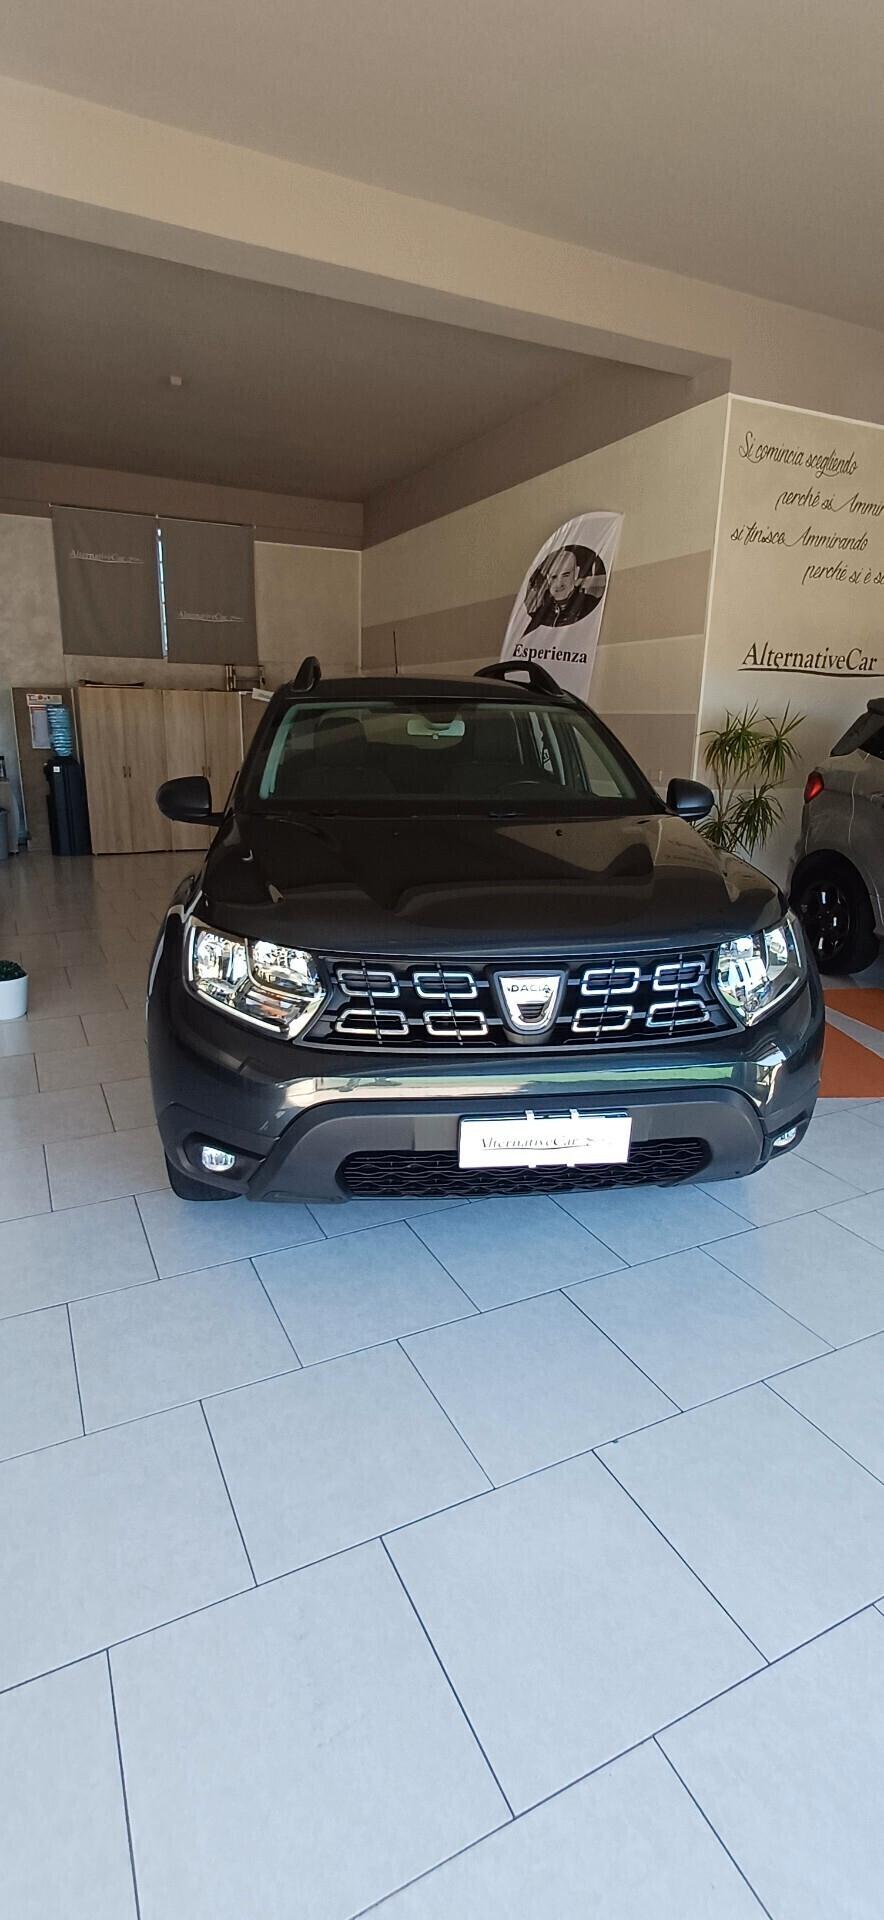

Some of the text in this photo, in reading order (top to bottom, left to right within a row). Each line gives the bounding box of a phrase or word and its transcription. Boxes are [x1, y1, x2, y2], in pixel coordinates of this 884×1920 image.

[739, 430, 859, 478] Si comincia scegliendo
[774, 486, 820, 511] perché
[821, 494, 835, 512] si
[731, 523, 744, 542] si
[787, 526, 869, 551] Ammirando
[801, 560, 849, 585] perché
[849, 567, 863, 584] si
[512, 643, 588, 664] Esperienza
[742, 641, 877, 671] AlternativeCar
[510, 984, 551, 993] DACIA
